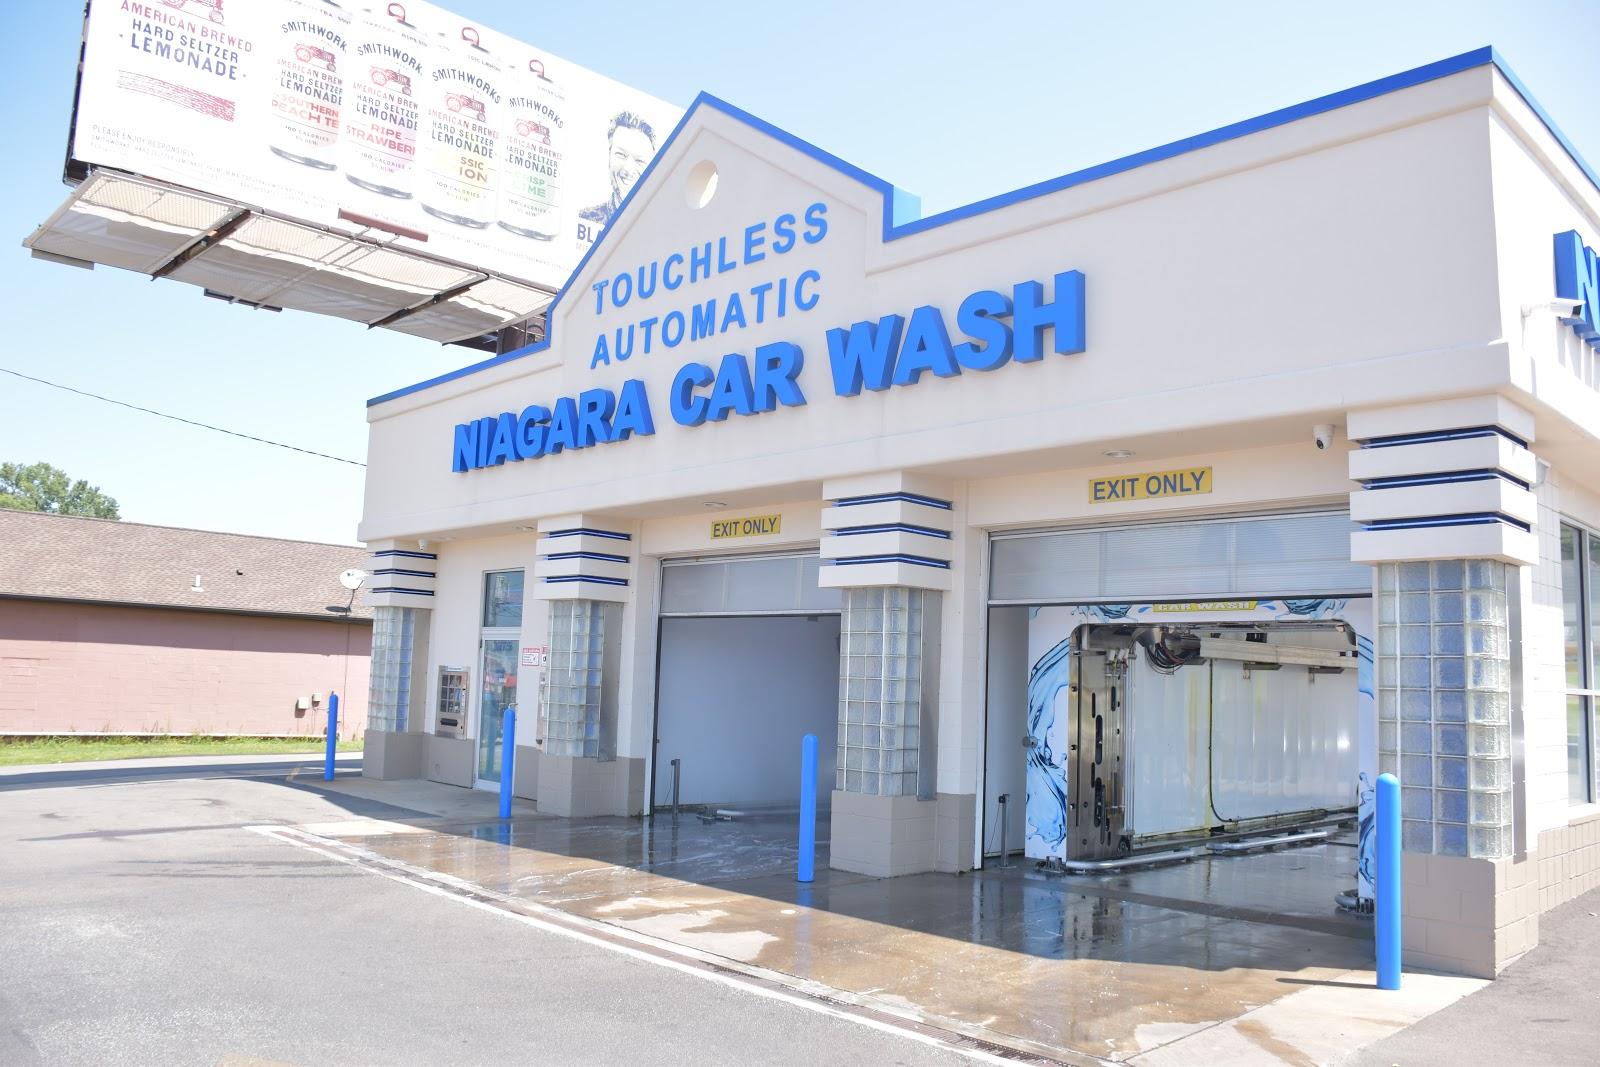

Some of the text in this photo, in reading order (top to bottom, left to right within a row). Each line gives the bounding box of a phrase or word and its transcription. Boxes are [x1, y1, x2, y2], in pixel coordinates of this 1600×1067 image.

[121, 0, 252, 53] AMERICAN BREWED
[132, 18, 239, 64] HARD SELTZER
[282, 20, 347, 53] SMITHWORK
[131, 33, 238, 80] LEMONADE
[357, 43, 423, 76] SMITHWORK
[281, 69, 305, 83] HARD
[432, 68, 501, 104] SMITHWORKS
[371, 123, 403, 139] RIPE
[431, 129, 494, 159] LEMONADE
[432, 120, 494, 147] HARD SELTZER
[527, 152, 558, 169] SELTZER
[593, 203, 828, 315] TOUCHLESS
[590, 270, 821, 370] AUTOMATIC
[452, 269, 1087, 473] NIAGARA CAR WASH
[1093, 471, 1205, 501] EXIT ONLY
[713, 517, 777, 538] EXIT ONLY
